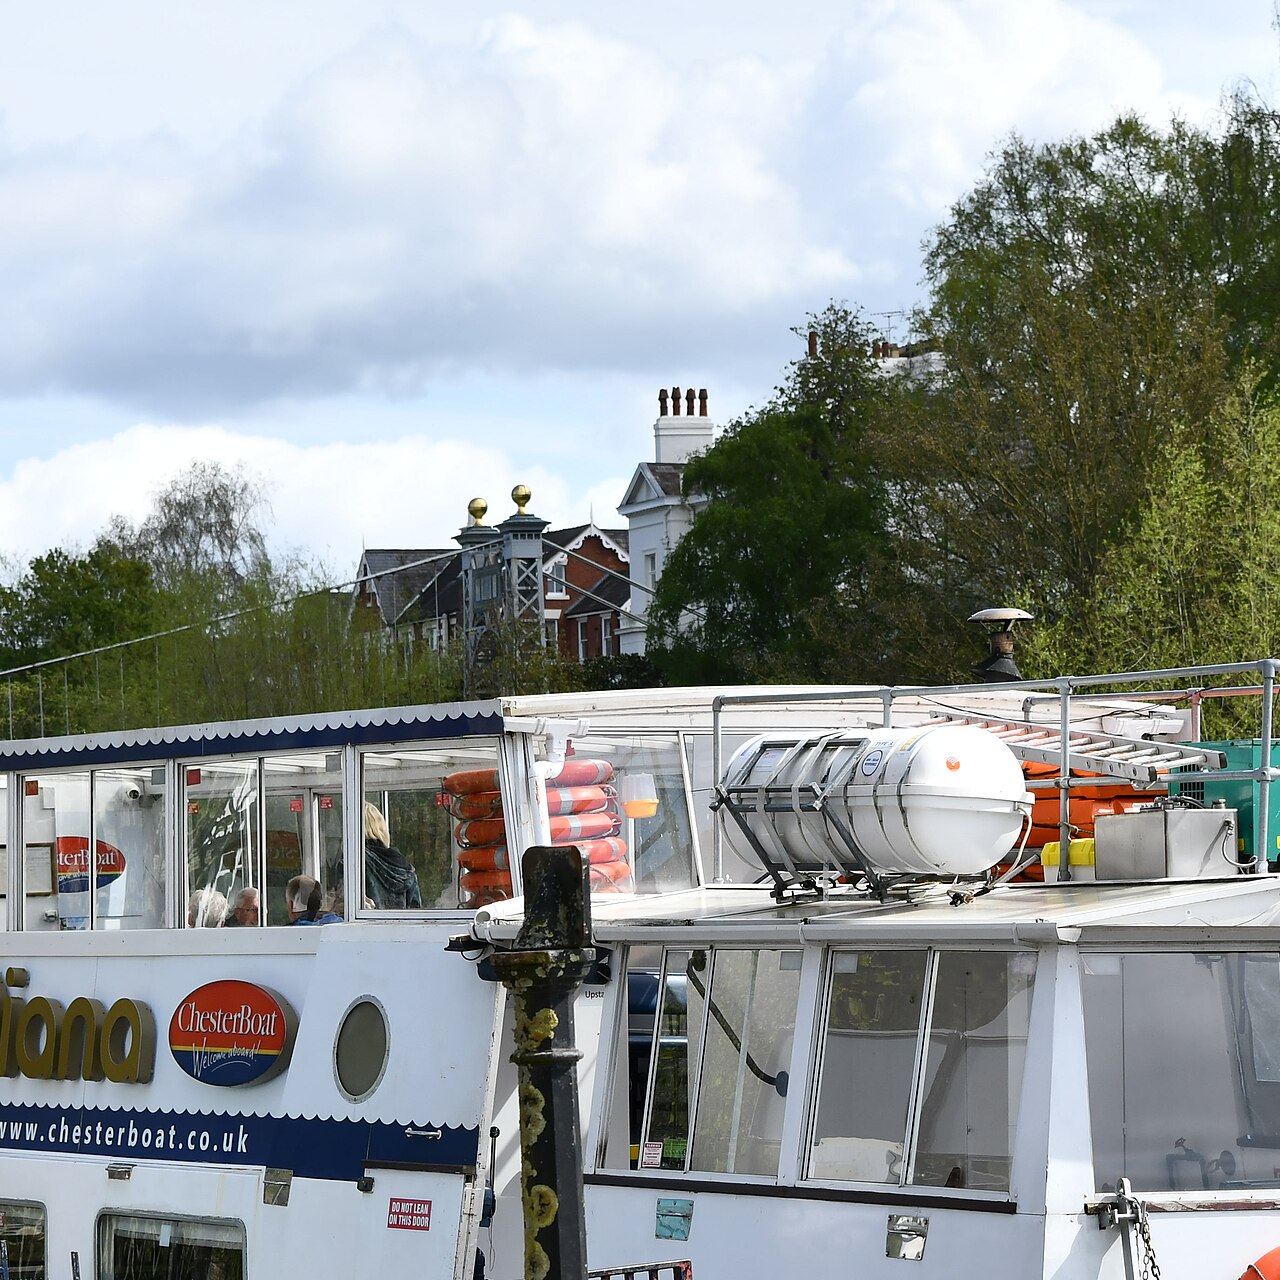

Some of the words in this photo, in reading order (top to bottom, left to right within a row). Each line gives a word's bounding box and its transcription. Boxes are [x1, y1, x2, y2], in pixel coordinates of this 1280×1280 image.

[177, 1001, 278, 1037] ChesterBoat
[192, 1036, 227, 1077] Welcome
[227, 1039, 262, 1063] aboard!
[391, 1201, 400, 1213] DO
[401, 1202, 413, 1213] NOT
[413, 1203, 429, 1215] LEAN
[388, 1214, 397, 1225] ON
[398, 1215, 412, 1226] THIS
[412, 1216, 430, 1228] DOOR
